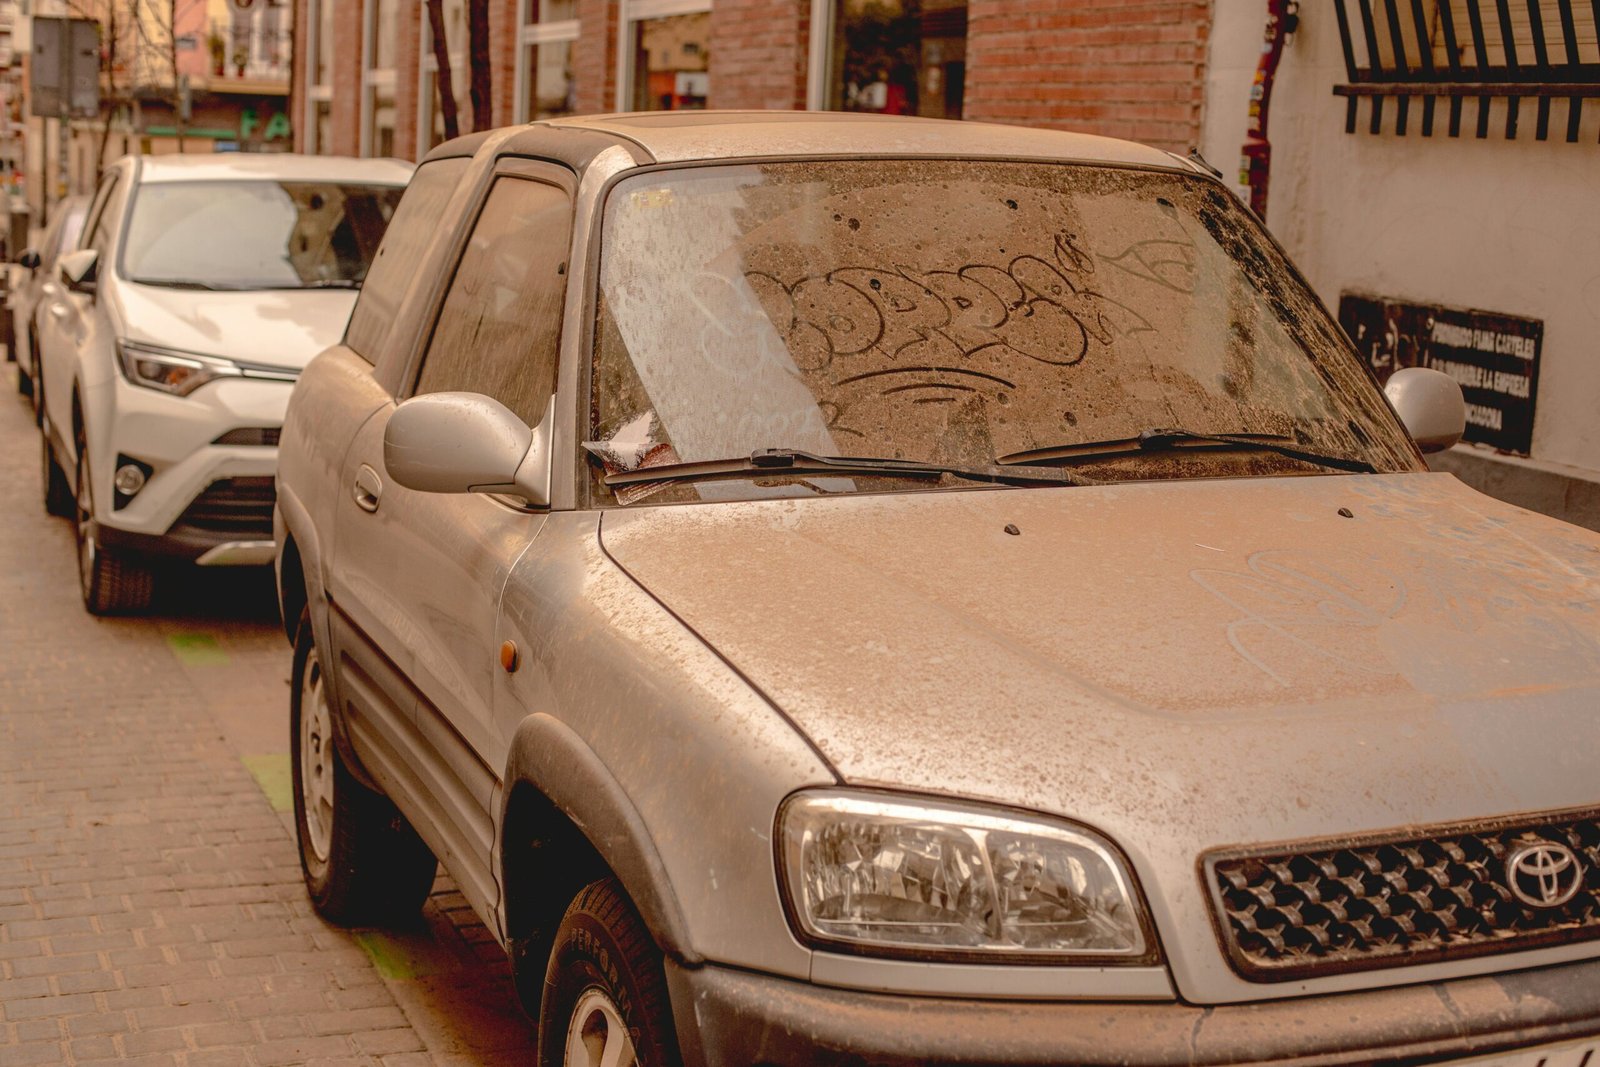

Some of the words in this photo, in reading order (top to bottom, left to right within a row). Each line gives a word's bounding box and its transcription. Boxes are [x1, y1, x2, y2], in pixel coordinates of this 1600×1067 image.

[1496, 333, 1535, 359] CARTELES
[1483, 369, 1493, 389] LA
[1493, 370, 1530, 399] EMPRESA
